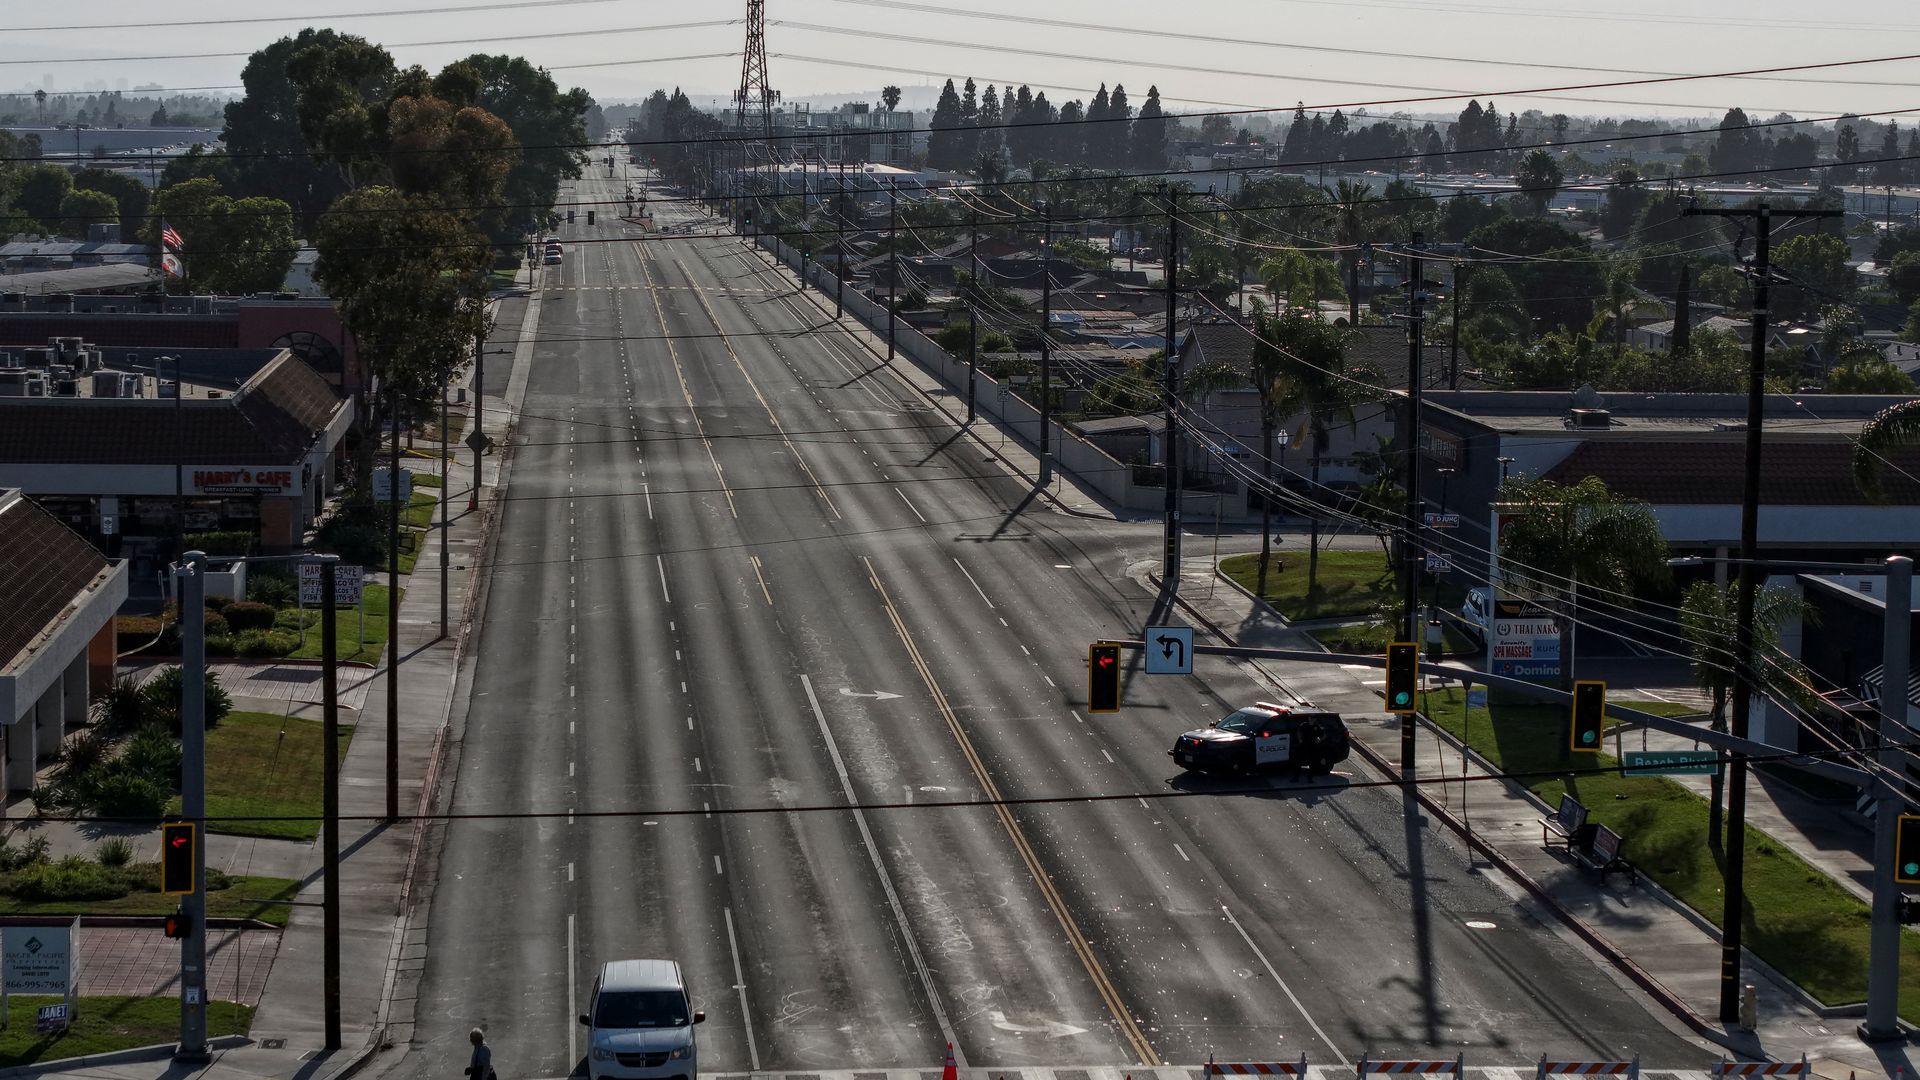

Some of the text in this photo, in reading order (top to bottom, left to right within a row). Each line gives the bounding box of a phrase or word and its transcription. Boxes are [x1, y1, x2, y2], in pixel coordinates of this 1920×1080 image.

[193, 468, 291, 488] HARRY'S CAFE
[1513, 625, 1534, 635] THAI
[1536, 624, 1560, 635] NAKO
[1493, 645, 1532, 658] SPA MASSAGE
[1635, 756, 1708, 769] Beach Blvd
[5, 981, 65, 989] 866-995-7965
[38, 1006, 66, 1019] JANET
